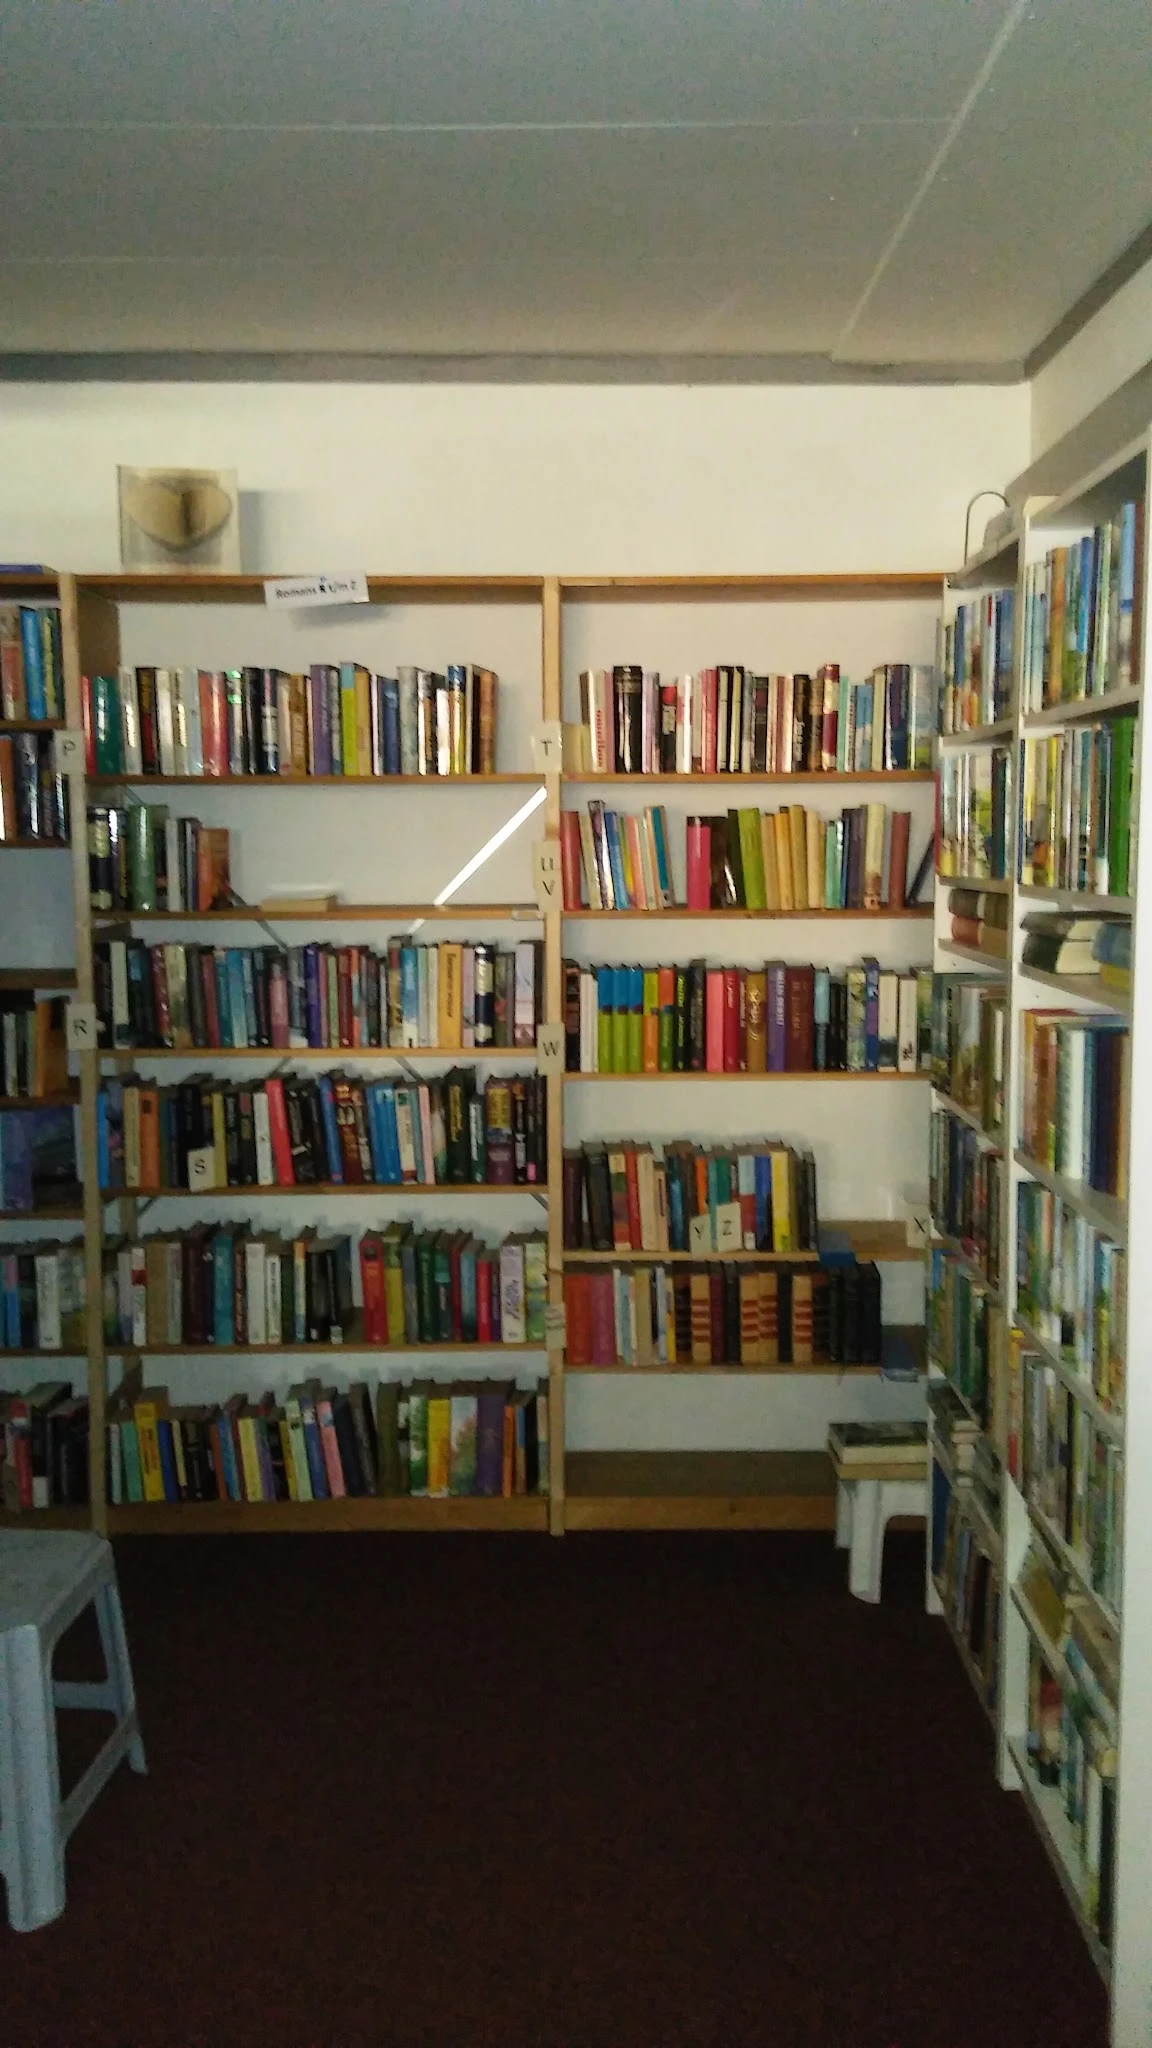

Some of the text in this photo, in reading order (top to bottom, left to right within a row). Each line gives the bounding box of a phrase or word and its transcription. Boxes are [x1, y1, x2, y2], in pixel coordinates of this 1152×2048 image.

[275, 587, 317, 599] Romans
[63, 740, 76, 756] P
[541, 740, 552, 756] T
[543, 880, 555, 896] V
[73, 1019, 87, 1036] R
[542, 1041, 559, 1056] W
[195, 1158, 206, 1175] S
[722, 1219, 732, 1236] Z
